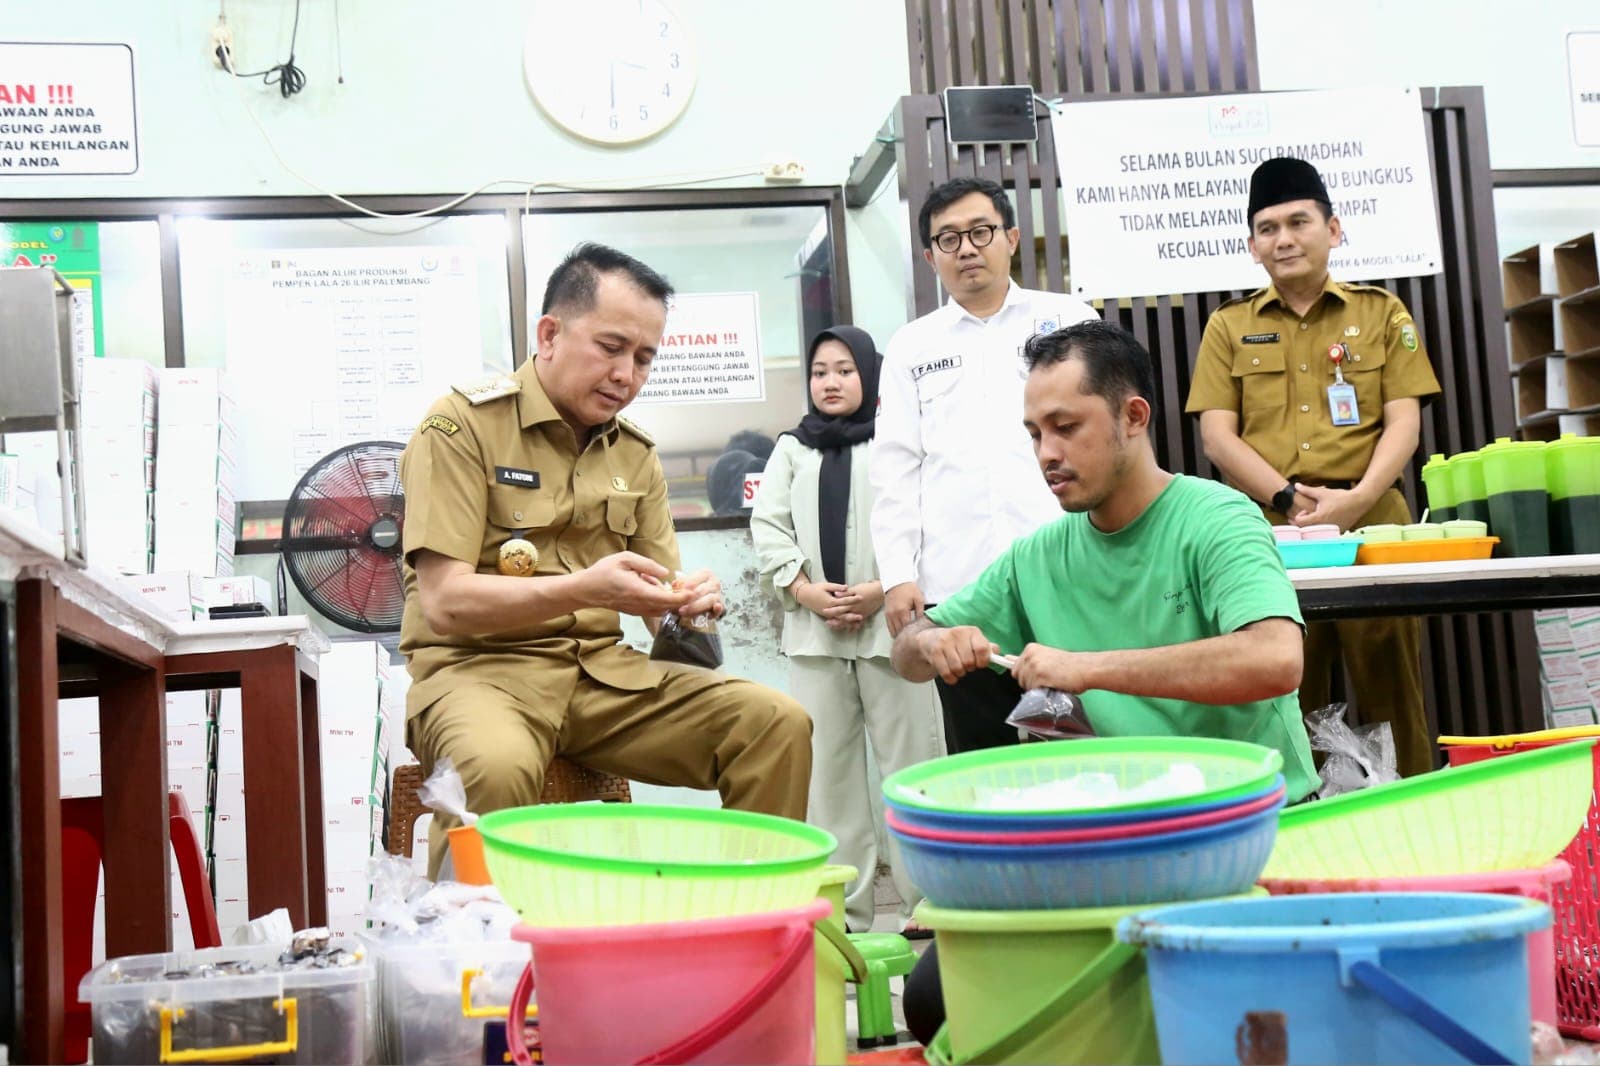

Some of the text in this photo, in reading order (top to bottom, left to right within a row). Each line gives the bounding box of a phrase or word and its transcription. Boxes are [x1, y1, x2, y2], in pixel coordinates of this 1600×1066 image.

[659, 22, 669, 38] 2
[670, 52, 680, 69] 3
[48, 85, 74, 104] !!!
[661, 82, 671, 98] 4
[0, 107, 95, 117] WAAN ANDA
[639, 104, 648, 120] 5
[50, 124, 102, 134] JAWAB
[609, 114, 619, 130] 6
[30, 140, 129, 151] KEHILANGAN
[18, 157, 60, 167] ANDA
[1120, 141, 1364, 172] SELAMA BULAN SUCI RAMADHAN
[1076, 186, 1116, 204] KAMI
[1119, 182, 1171, 203] HANYA
[1174, 178, 1249, 200] MELAYANI
[1341, 166, 1414, 188] BUNGKUS
[1120, 213, 1166, 232] TIDAK
[1168, 208, 1243, 230] MELAYANI
[1157, 240, 1220, 260] KECUALI
[1222, 237, 1250, 255] WA
[1362, 255, 1394, 266] MODEL
[296, 267, 408, 278] BAGAN ALUR PRODUKSI
[272, 279, 311, 288] PEMPEK
[314, 279, 338, 287] LALA
[373, 277, 431, 286] PALEMBANG
[688, 351, 722, 359] BAWAAN
[723, 350, 746, 358] ANDA
[661, 363, 720, 373] BERTANGGUNG
[722, 361, 750, 370] JAWAB
[918, 358, 954, 376] FAHRI
[681, 376, 702, 384] ATAU
[704, 374, 755, 383] KEHILANGAN
[671, 388, 706, 396] BAWAAN
[707, 387, 729, 395] ANDA
